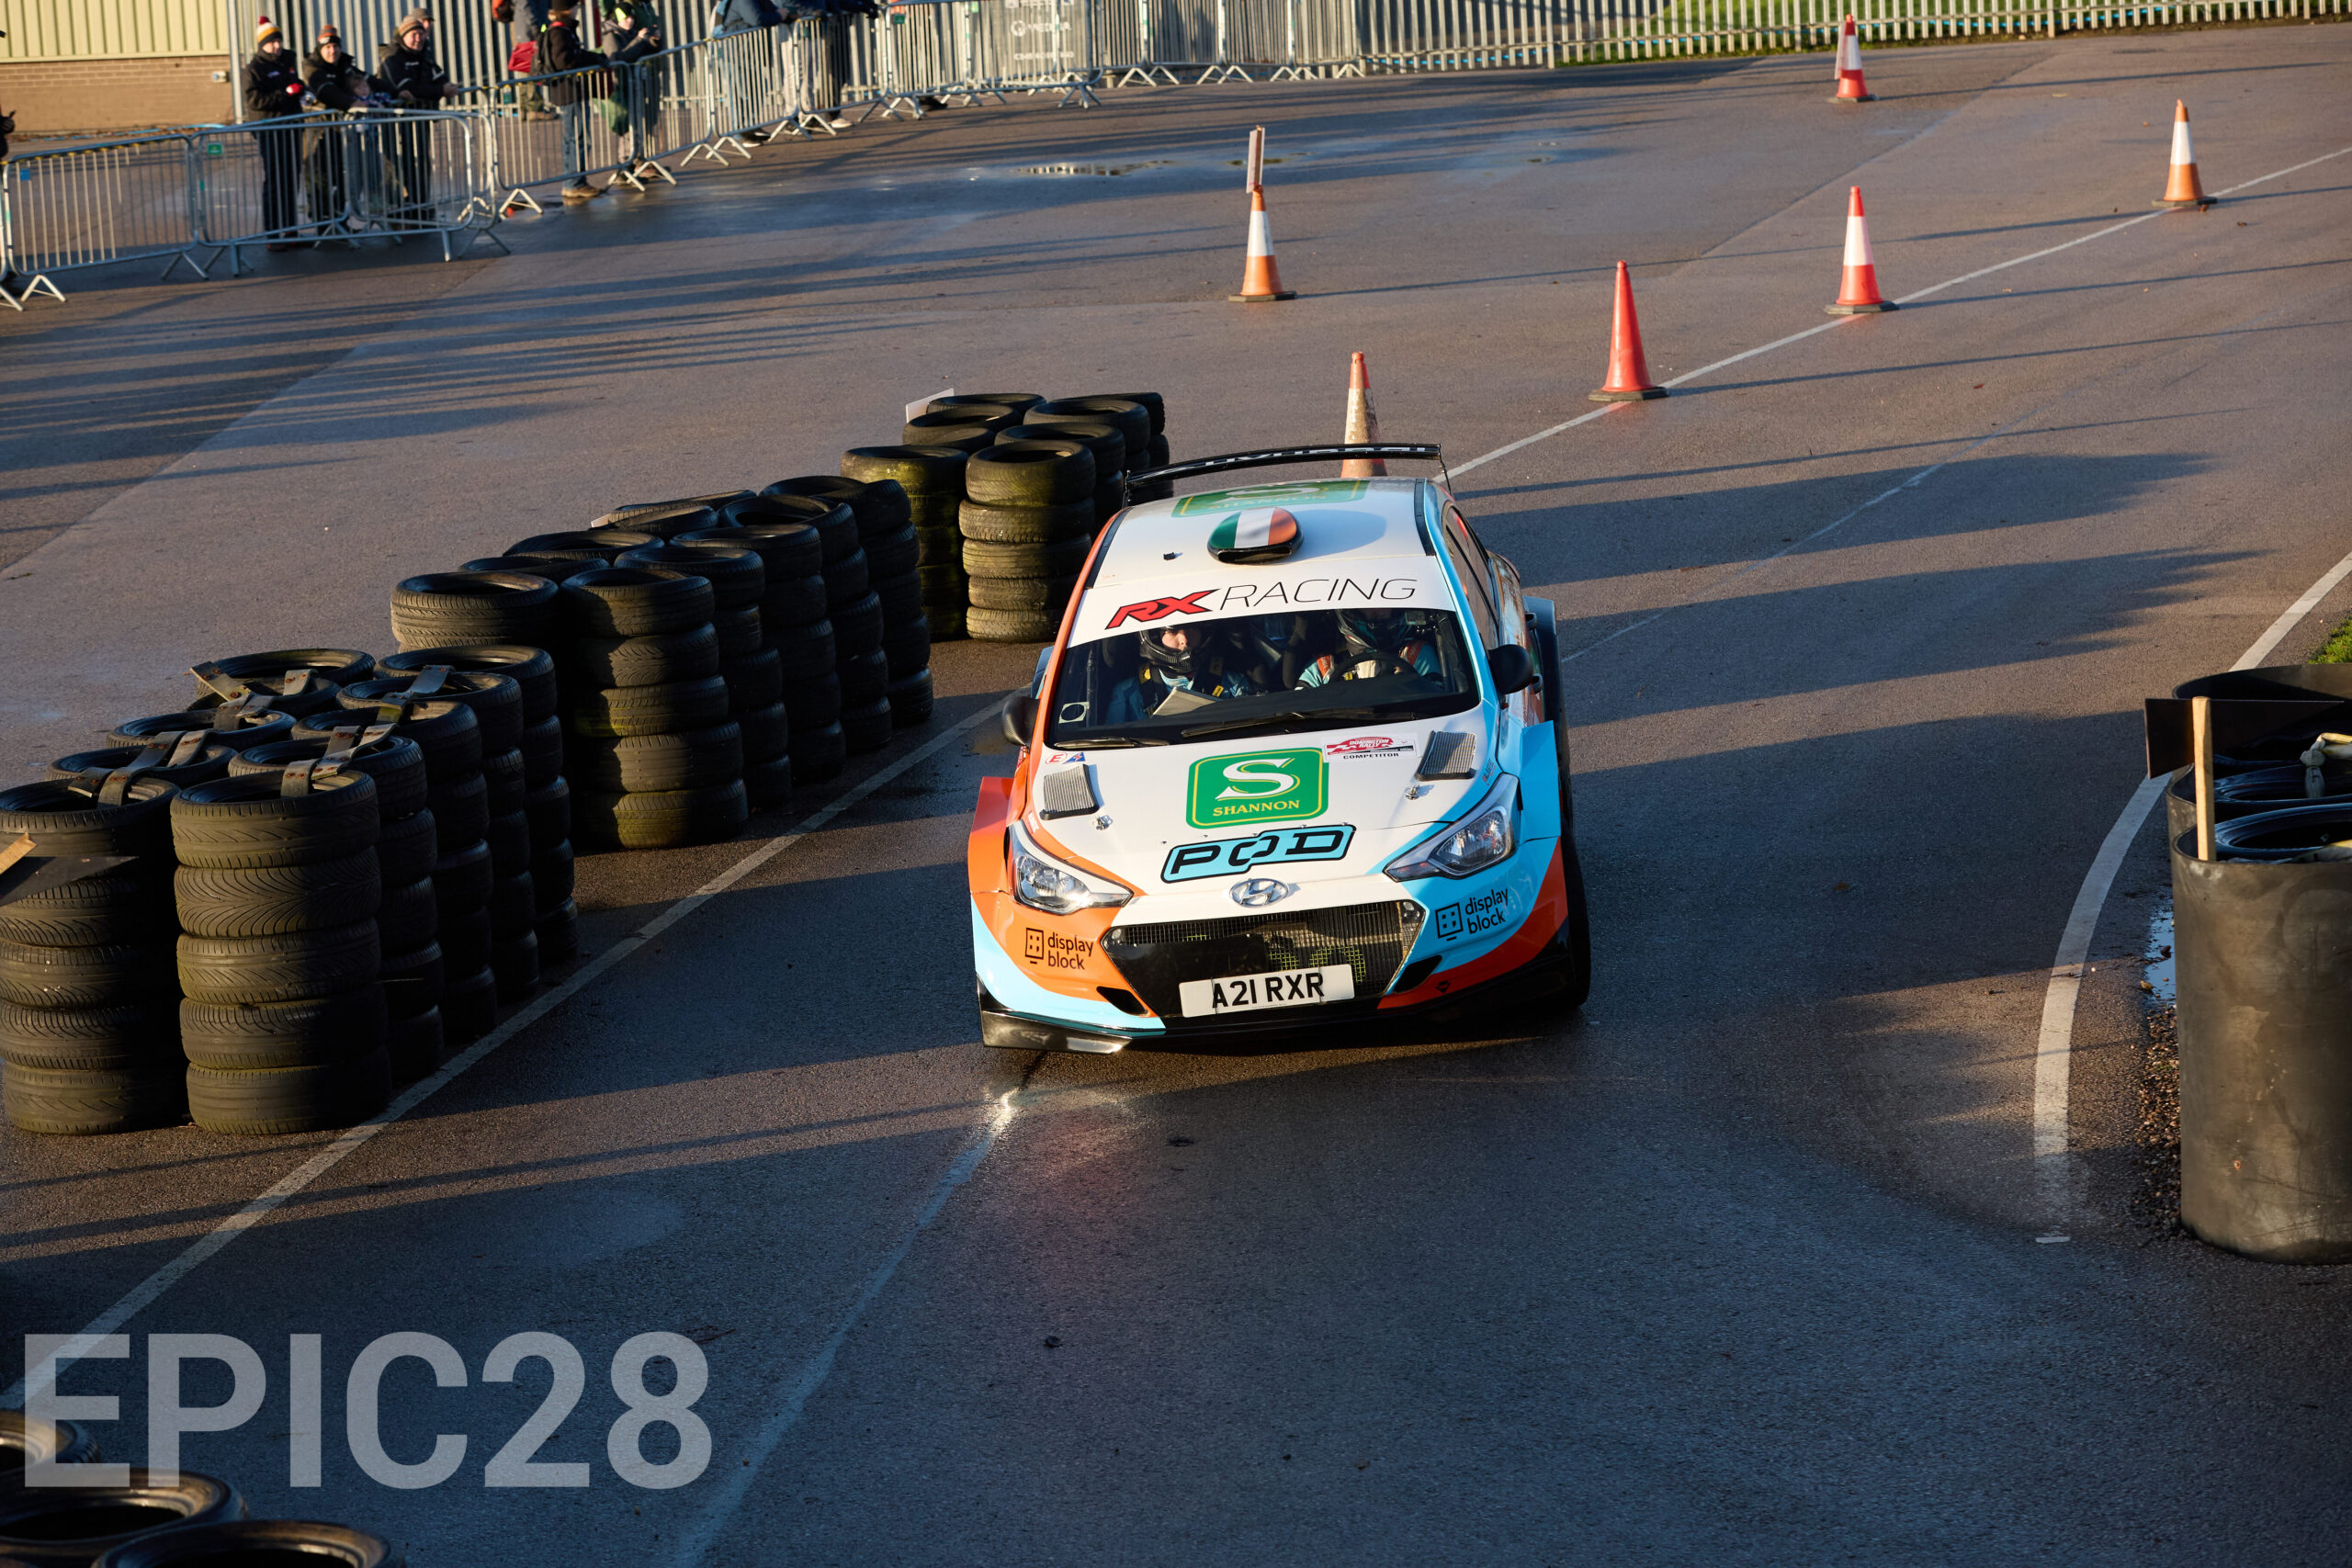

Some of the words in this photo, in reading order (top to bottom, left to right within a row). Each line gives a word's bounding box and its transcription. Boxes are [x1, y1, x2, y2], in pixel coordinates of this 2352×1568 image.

[1104, 588, 1222, 631] RX
[1220, 578, 1418, 611] RACING
[1049, 754, 1064, 762] E
[1213, 800, 1300, 817] SHANNON
[1170, 829, 1344, 874] POD
[1464, 888, 1509, 916] display
[1466, 908, 1506, 934] block
[1047, 931, 1094, 957] display
[1047, 950, 1085, 970] block
[1212, 978, 1258, 1009] A21
[1264, 972, 1325, 1002] RXR
